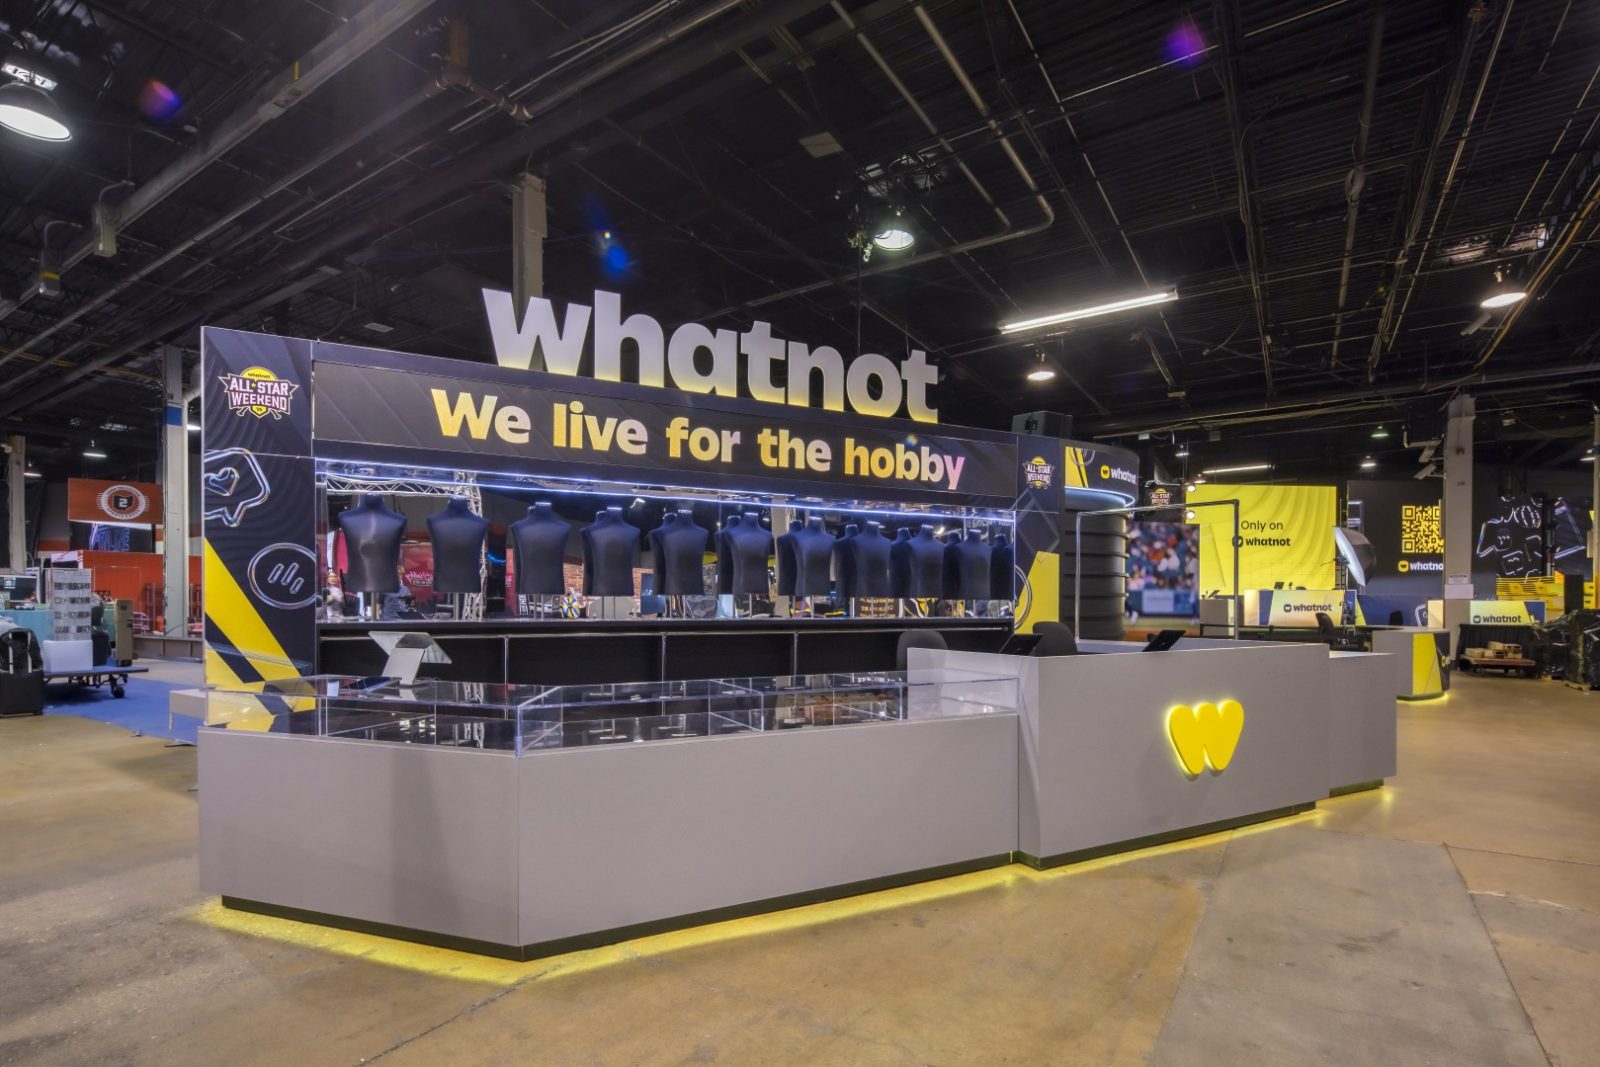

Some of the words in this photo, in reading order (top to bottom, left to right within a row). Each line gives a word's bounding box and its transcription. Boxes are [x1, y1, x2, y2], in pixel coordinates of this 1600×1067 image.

[481, 287, 939, 424] whatnot
[230, 377, 254, 393] ALL
[257, 382, 289, 396] STAR
[231, 391, 287, 411] WEEKEND
[430, 388, 532, 444] We
[552, 400, 648, 456] live
[665, 416, 741, 463] for
[757, 427, 832, 472] the
[844, 437, 966, 490] hobby
[1027, 464, 1036, 472] ALL
[1038, 465, 1051, 474] STAR
[118, 498, 128, 507] 2
[1241, 520, 1267, 533] Only
[1269, 522, 1284, 530] on
[1245, 537, 1291, 546] whatnot
[1410, 562, 1444, 571] whatno
[1293, 603, 1332, 612] whatnot
[1482, 615, 1522, 623] whatnot
